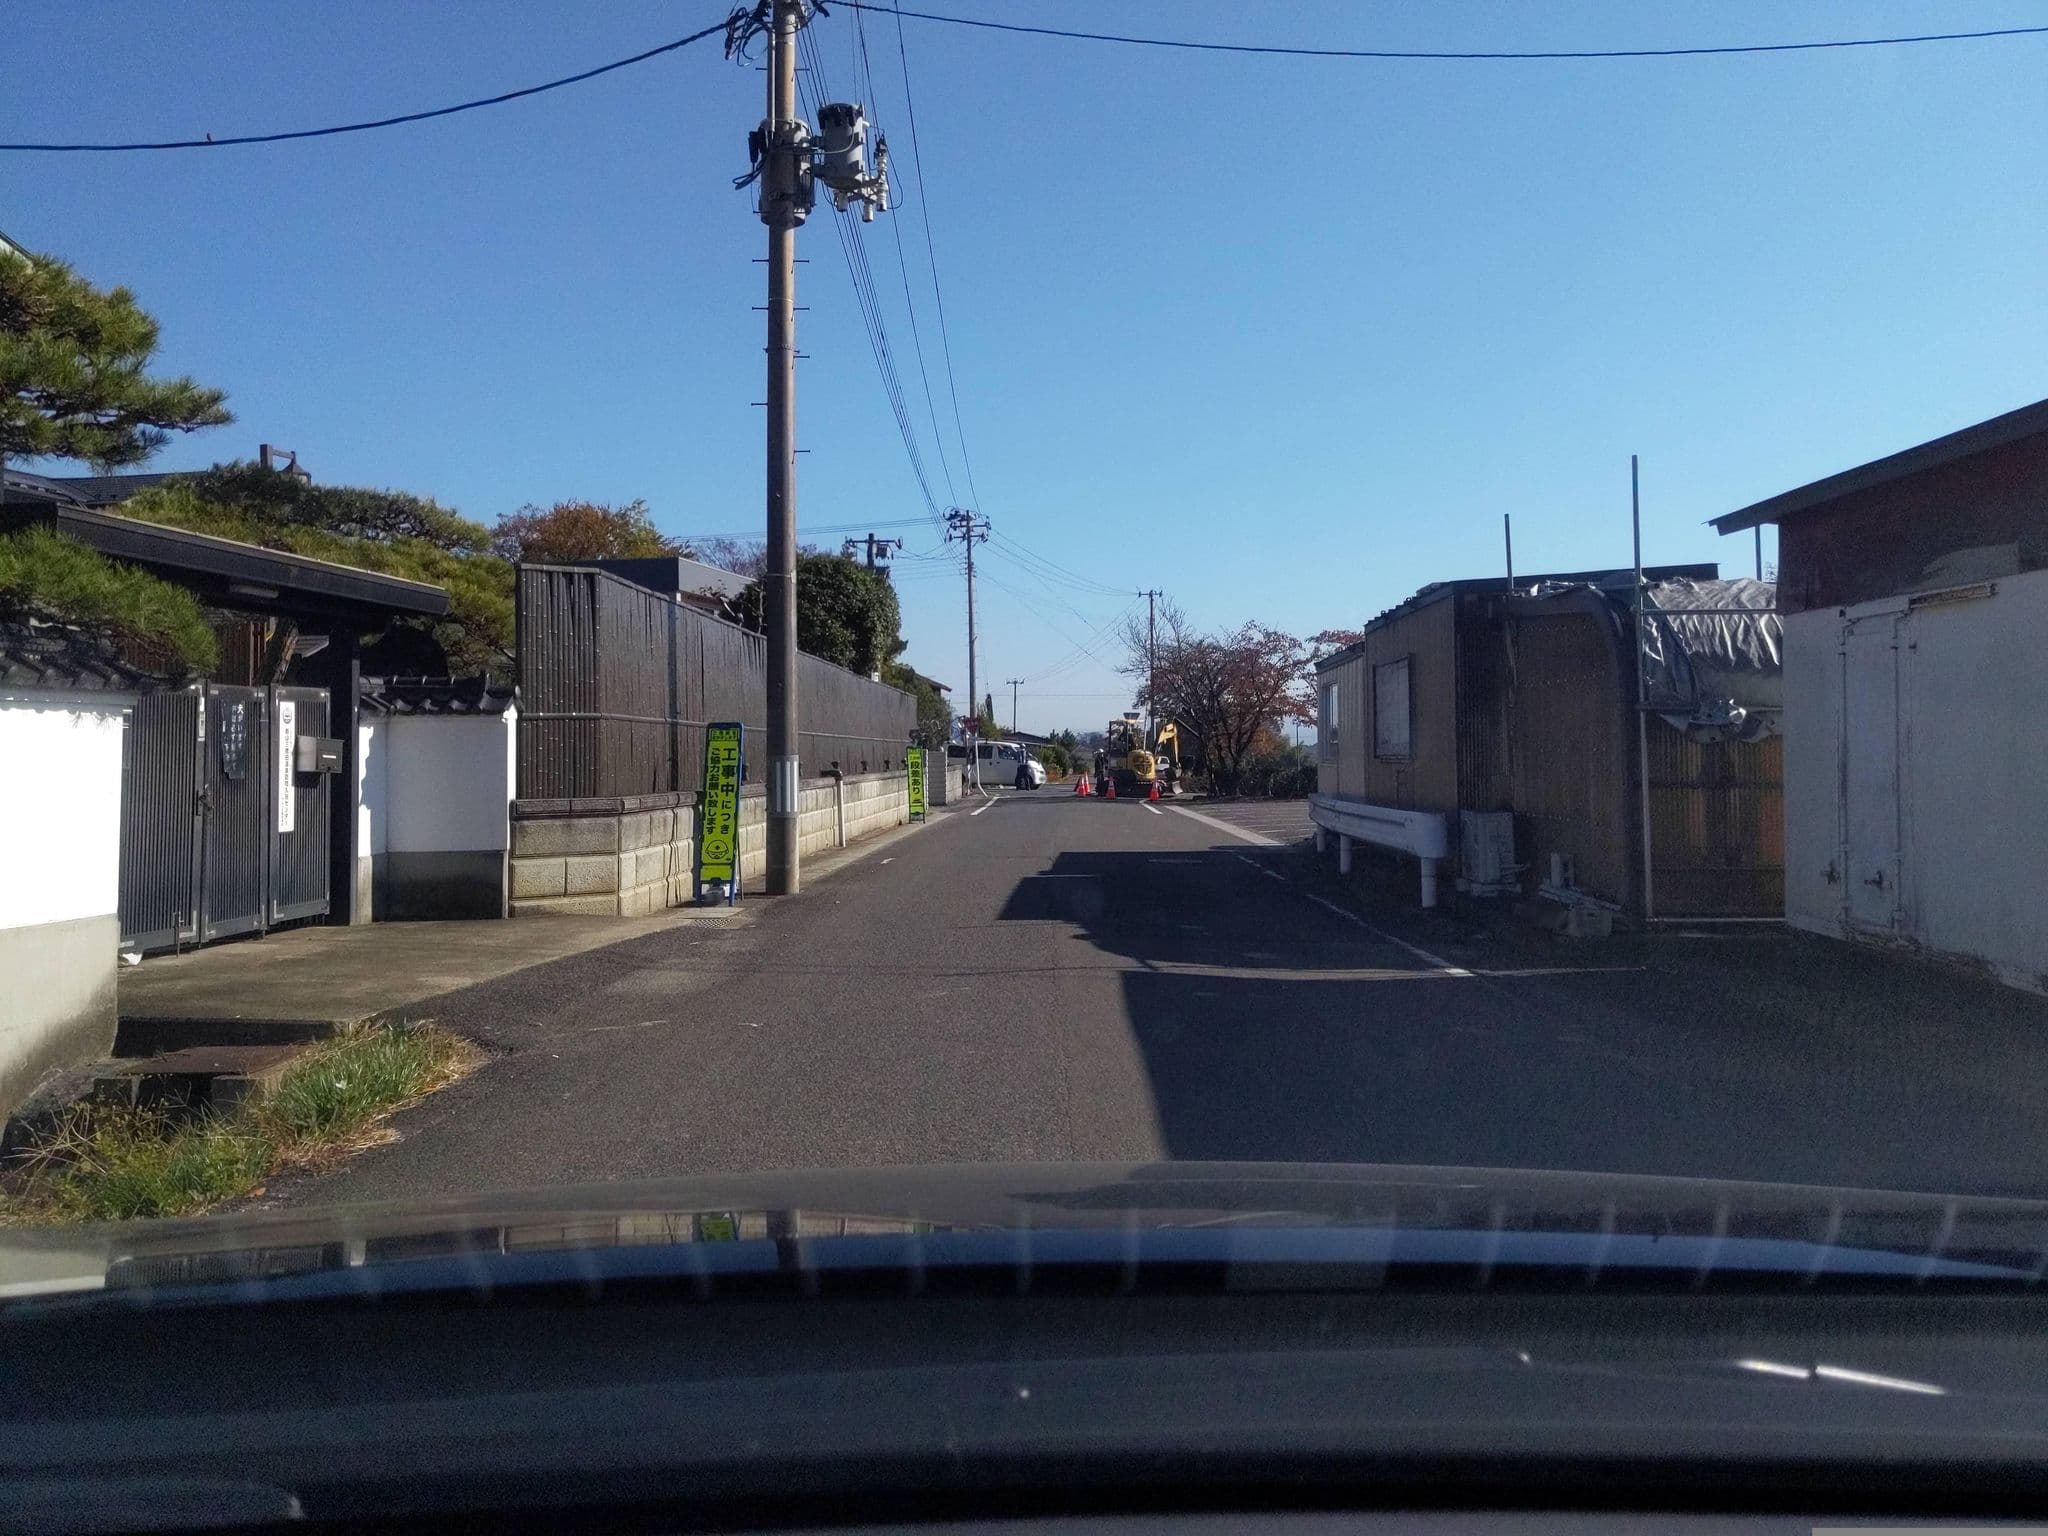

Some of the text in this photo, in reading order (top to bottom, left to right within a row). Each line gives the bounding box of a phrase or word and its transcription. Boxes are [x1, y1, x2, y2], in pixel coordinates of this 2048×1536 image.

[706, 747, 720, 834] ご協力お願い致します
[720, 748, 737, 834] 工事中につき
[910, 761, 921, 794] 段差あり
